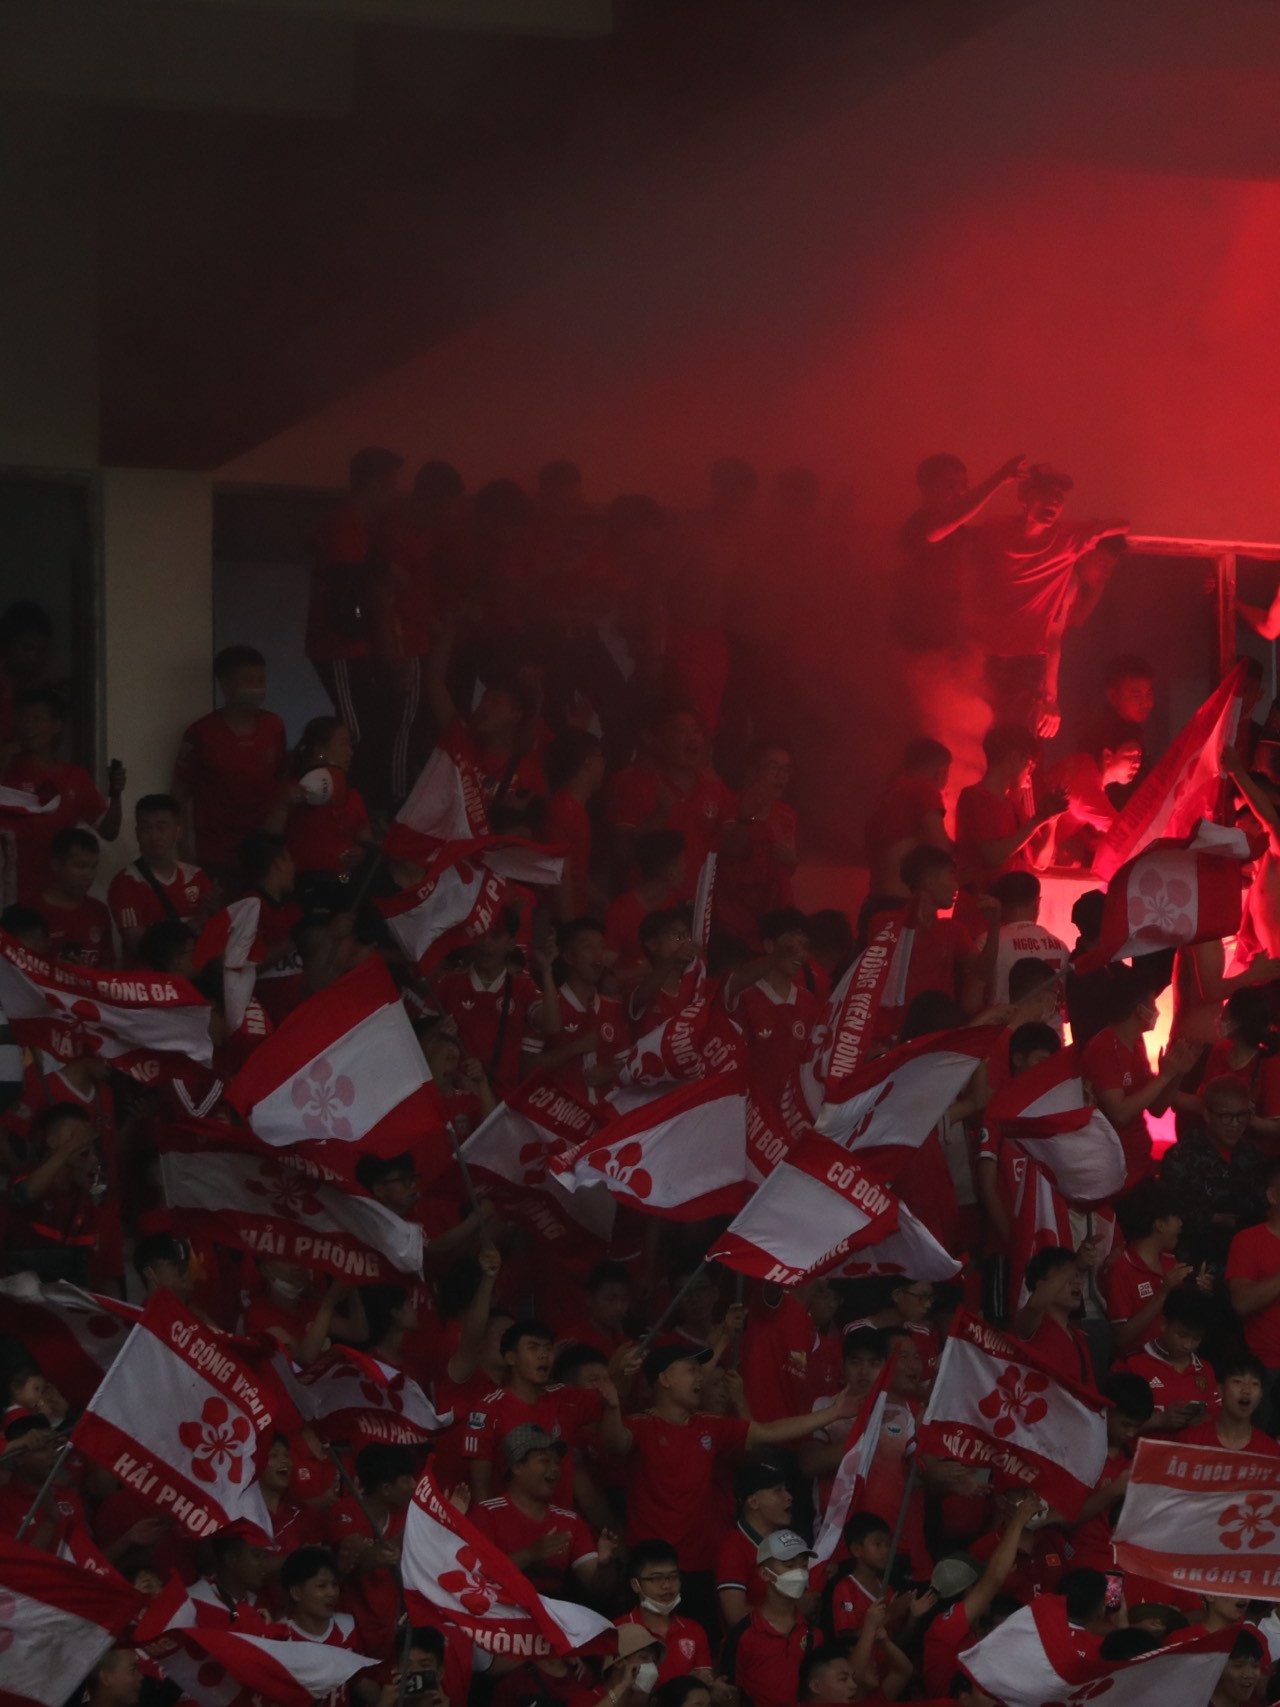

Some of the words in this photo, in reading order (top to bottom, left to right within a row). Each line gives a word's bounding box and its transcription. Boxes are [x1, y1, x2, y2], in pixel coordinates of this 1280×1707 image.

[97, 978, 150, 1002] BÓNG
[150, 980, 180, 1002] ĐÁ
[844, 993, 873, 1032] VIÊN
[826, 1161, 862, 1190] CỔ
[294, 1235, 380, 1278] PHÒNG
[171, 1319, 200, 1349] CỔ
[187, 1336, 237, 1384] ĐỘNG
[113, 1451, 160, 1496] HẢI
